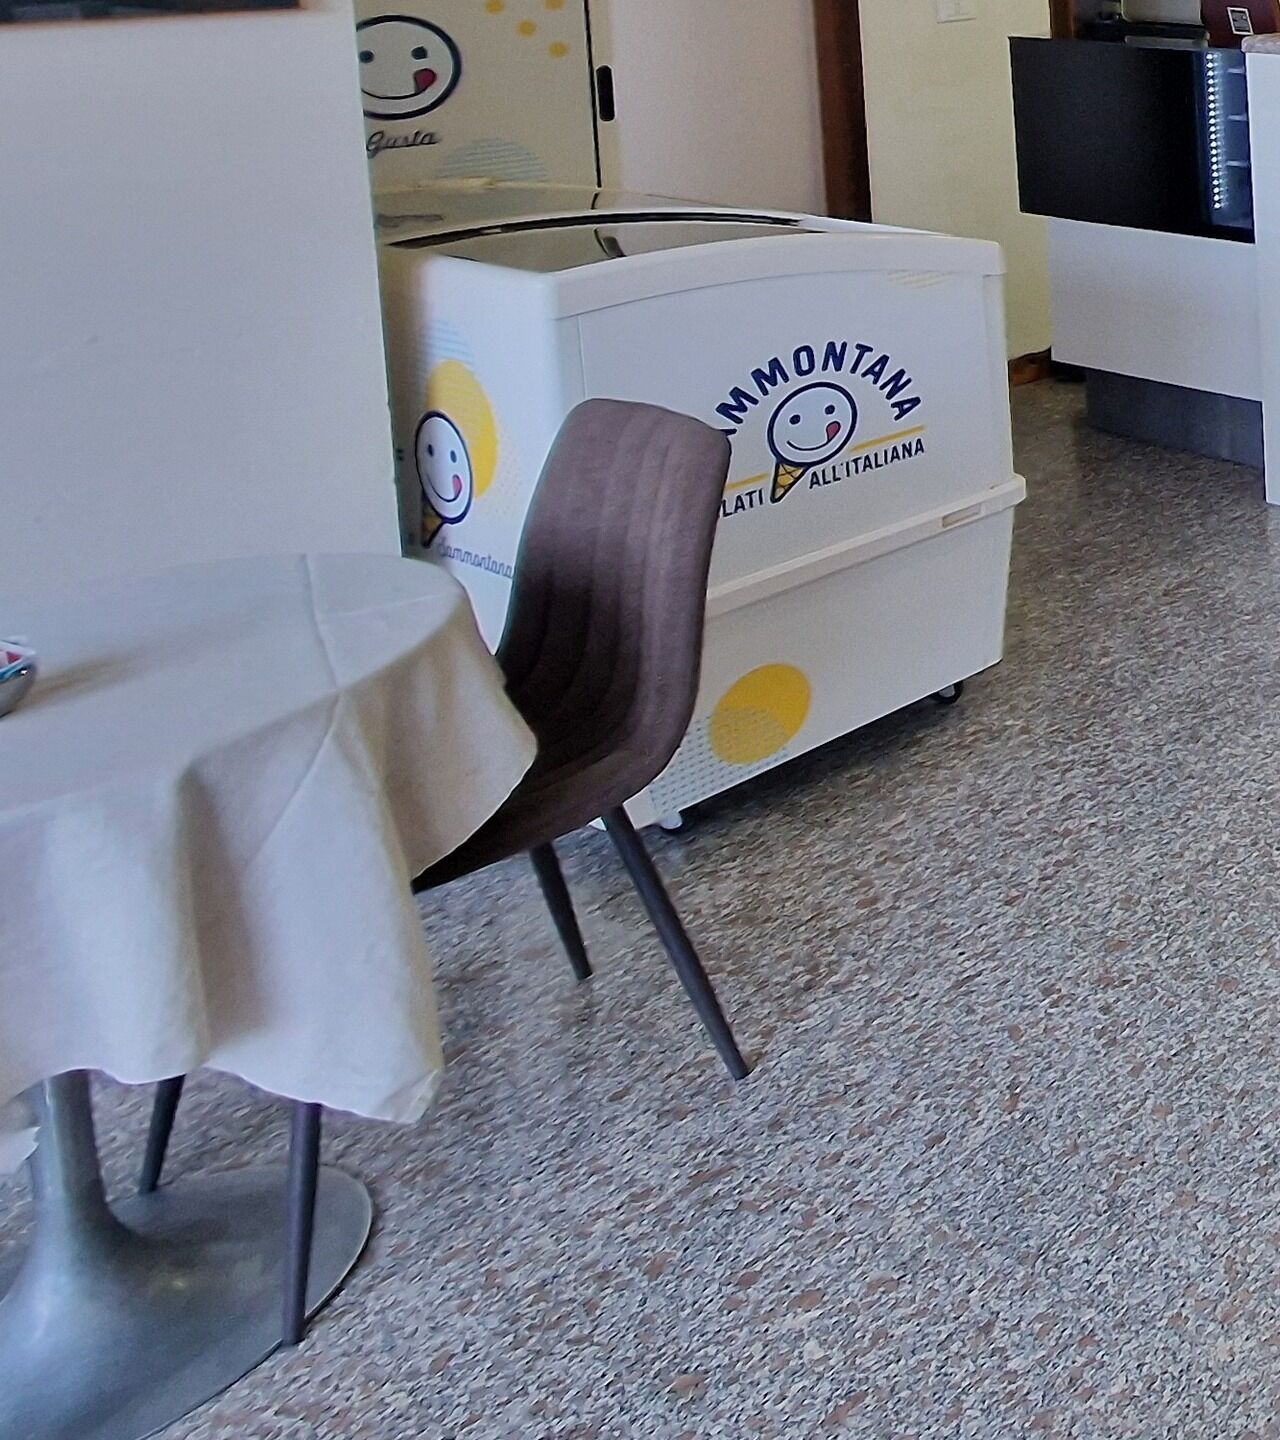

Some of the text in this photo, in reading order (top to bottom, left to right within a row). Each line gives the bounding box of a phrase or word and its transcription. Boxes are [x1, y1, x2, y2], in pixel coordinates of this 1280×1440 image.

[715, 341, 921, 436] MMONTANA
[720, 438, 925, 517] LATI ALL'ITALIANA
